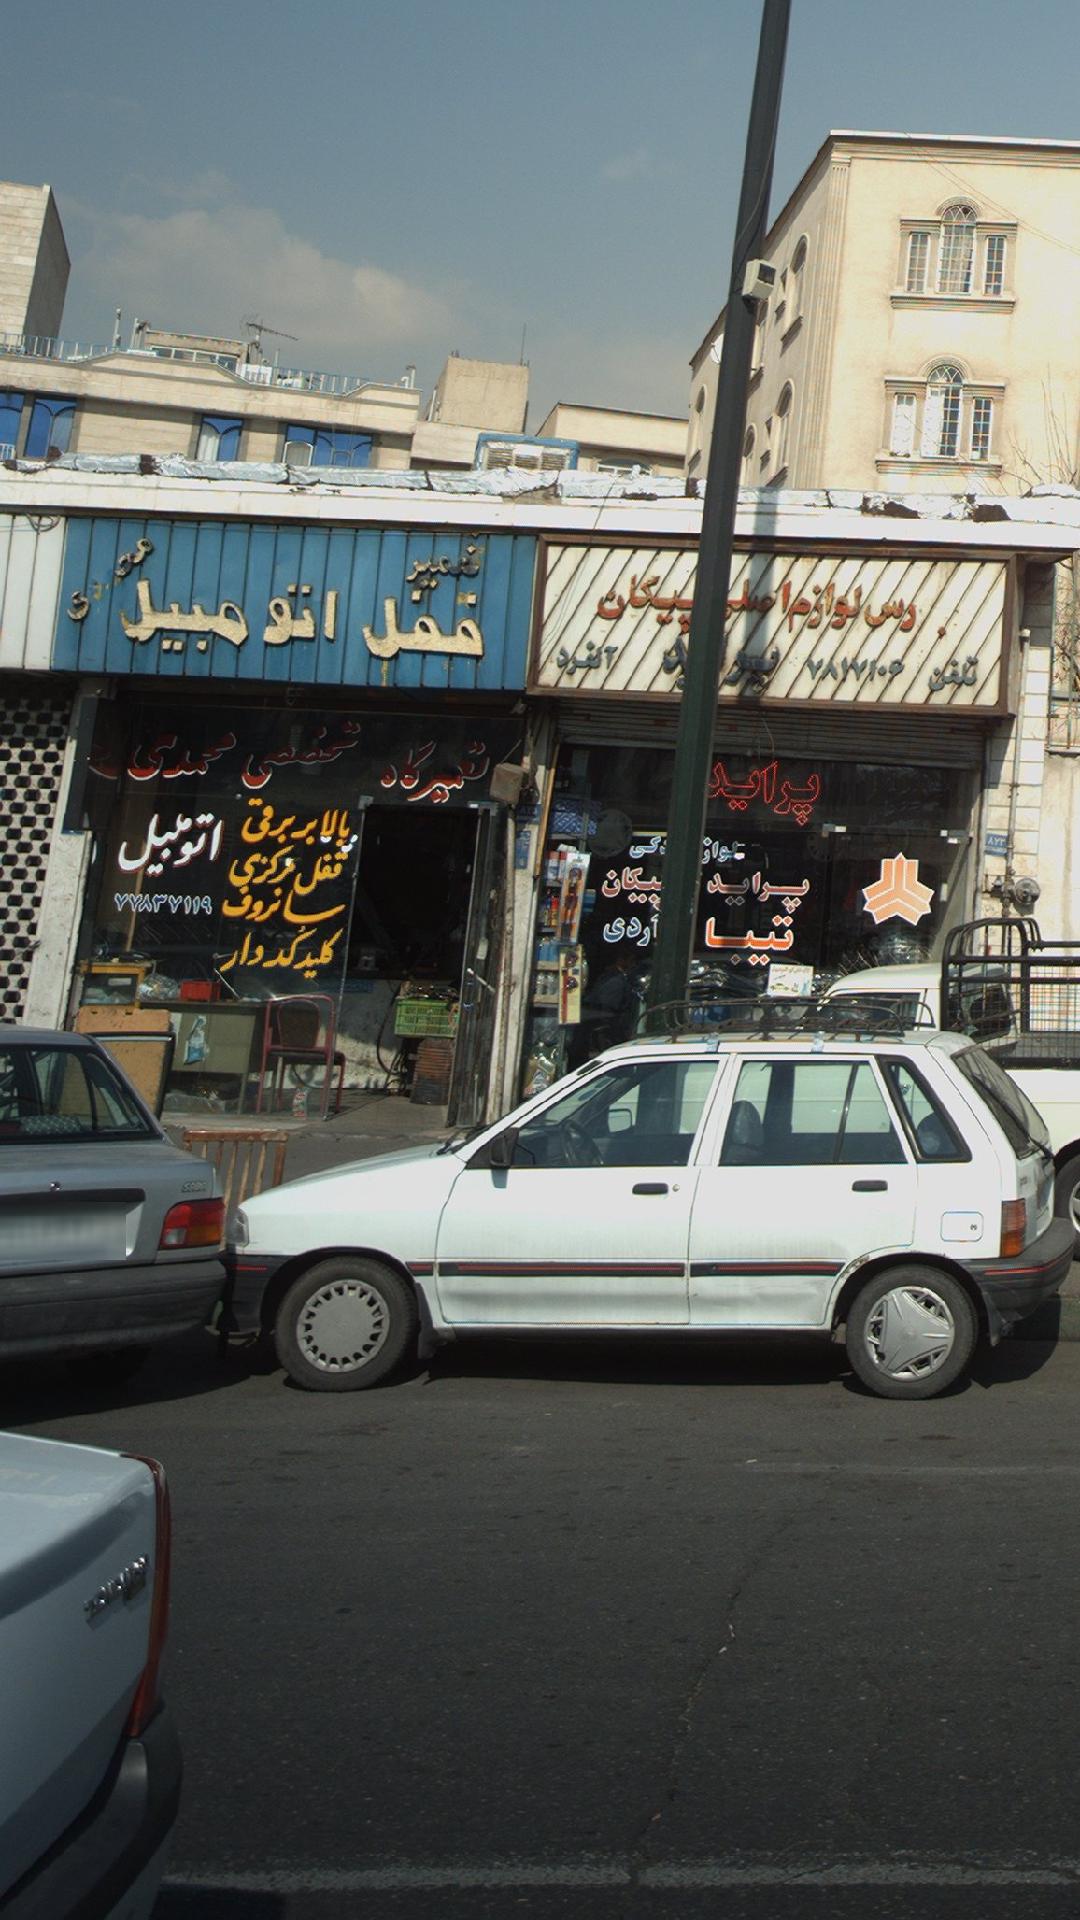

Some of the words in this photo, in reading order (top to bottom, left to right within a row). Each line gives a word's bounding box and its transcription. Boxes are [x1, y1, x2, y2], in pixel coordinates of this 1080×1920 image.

[927, 655, 979, 692] تلفن
[704, 760, 820, 827] پراید
[117, 812, 224, 876] اتومبیل
[113, 892, 213, 915] ۷۷۸۳۷۱۱۹
[707, 871, 811, 914] پراید
[705, 915, 795, 967] تیبا
